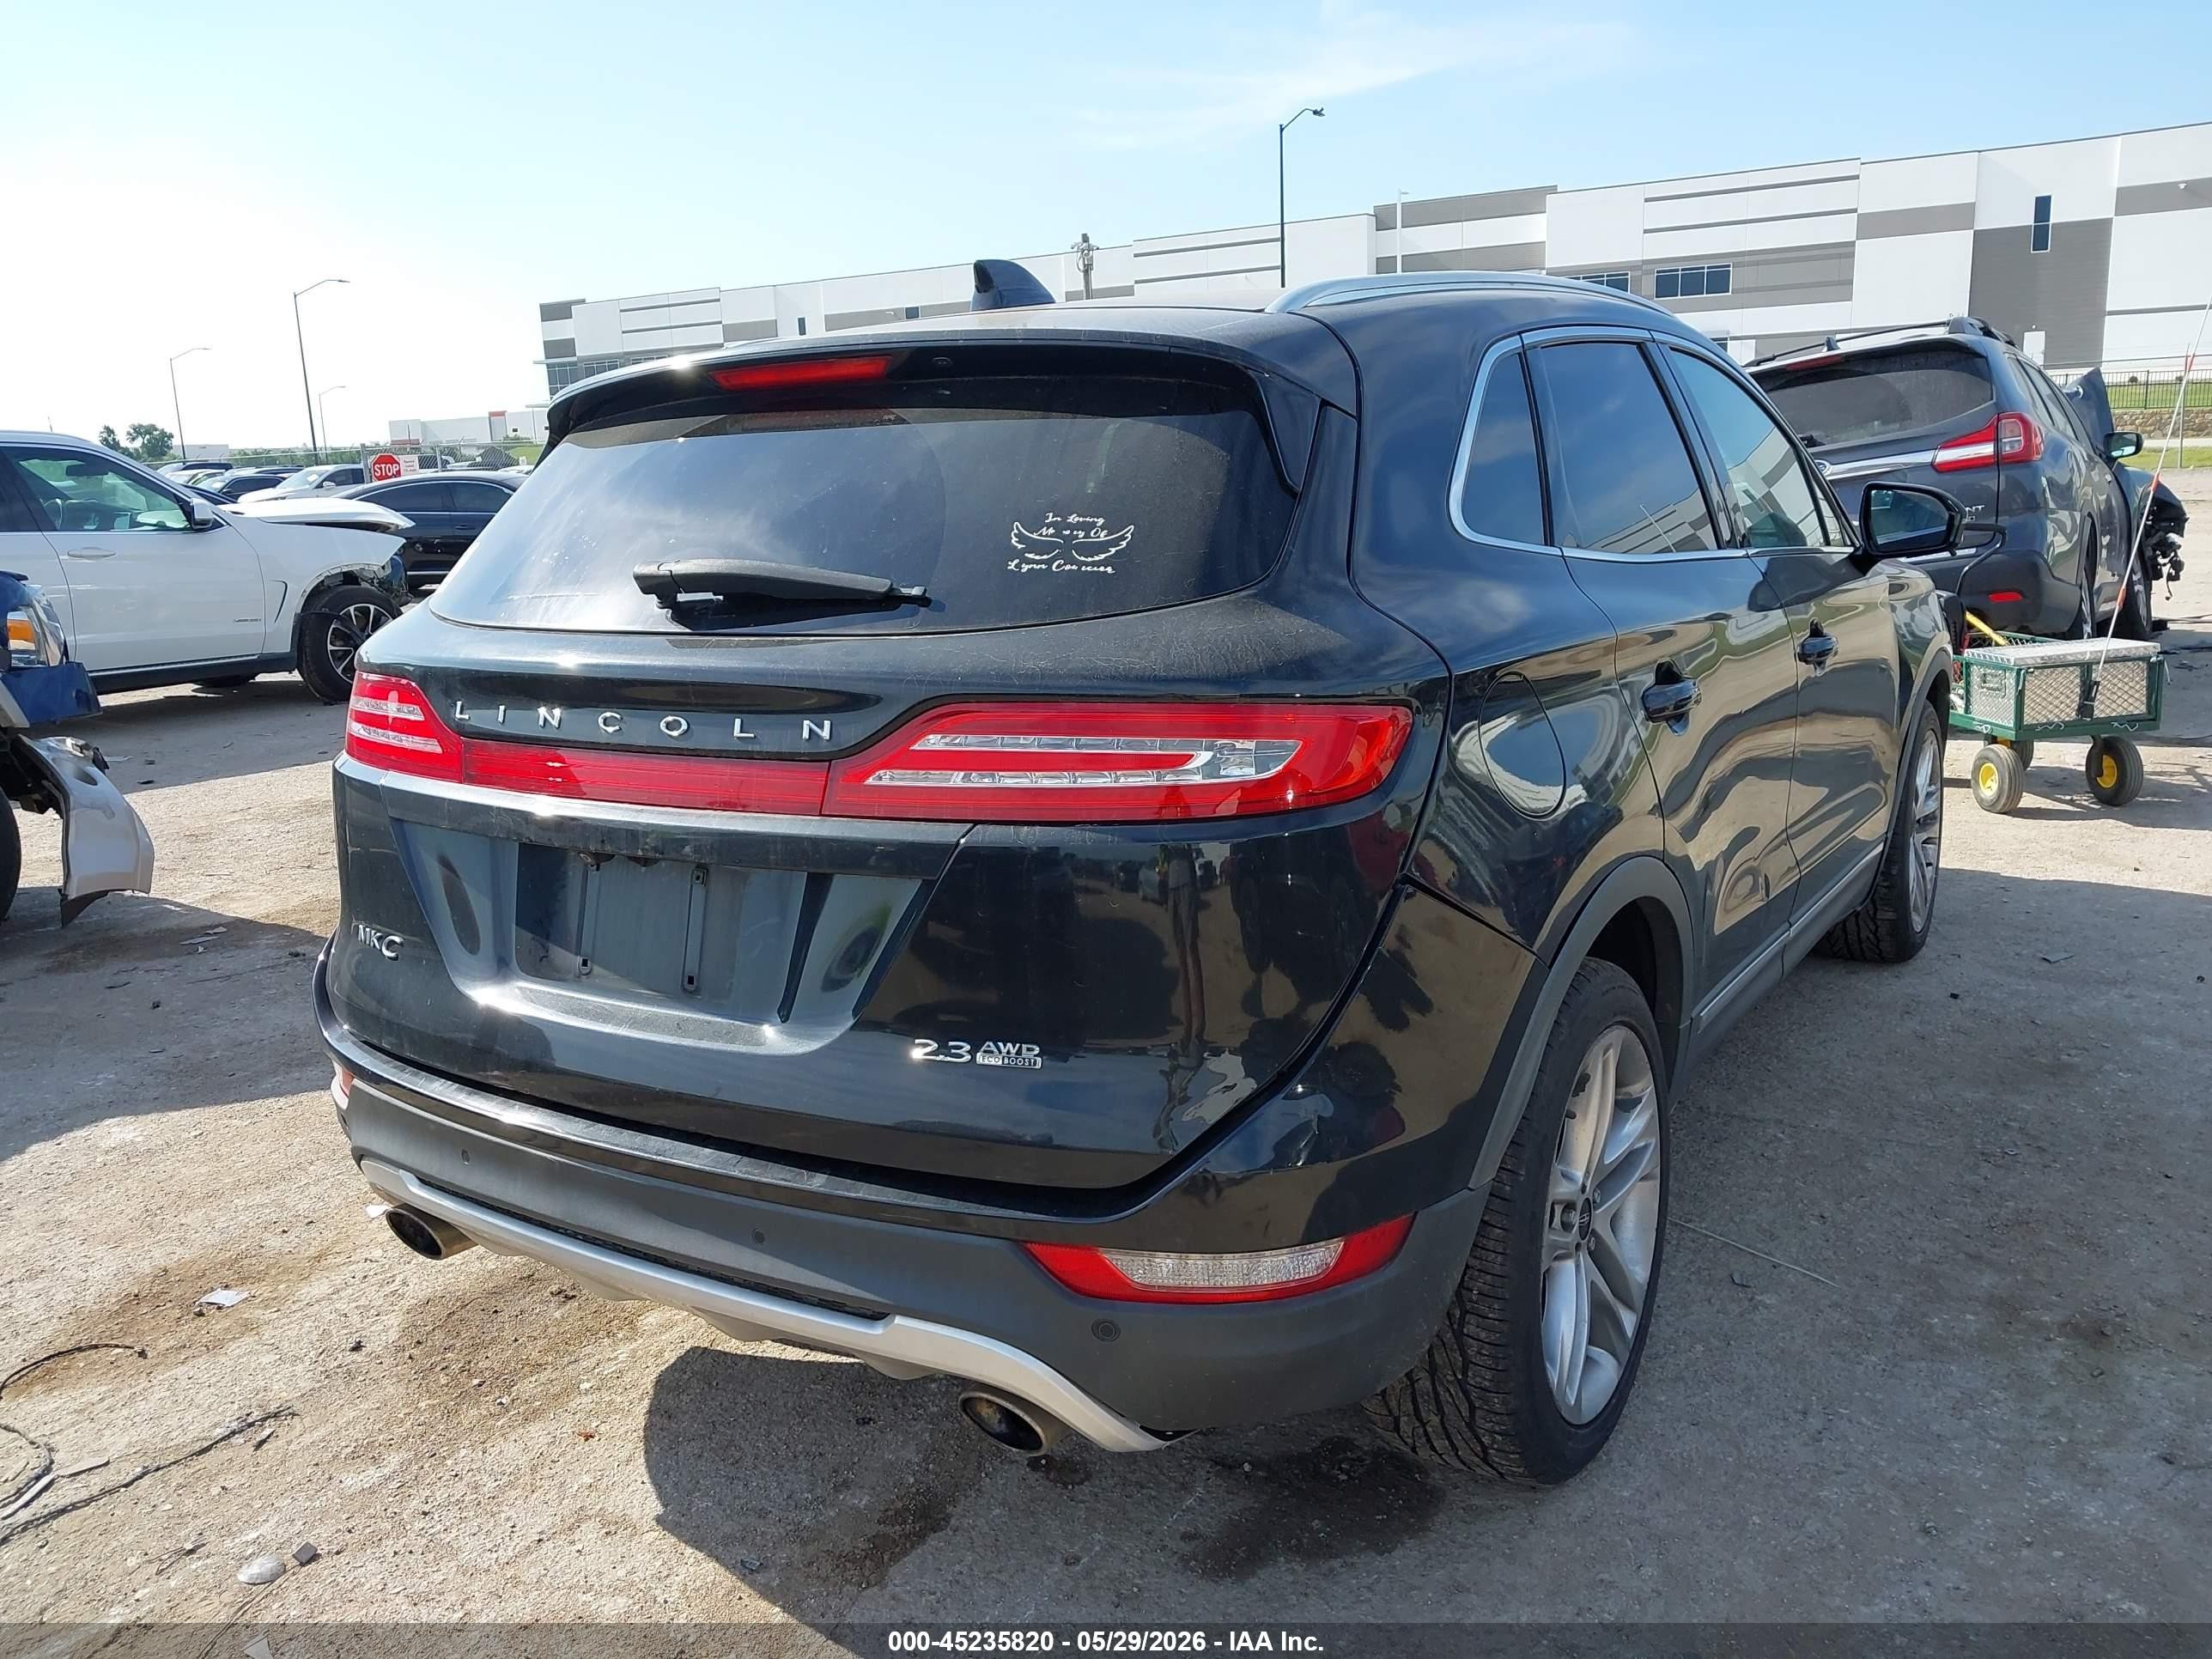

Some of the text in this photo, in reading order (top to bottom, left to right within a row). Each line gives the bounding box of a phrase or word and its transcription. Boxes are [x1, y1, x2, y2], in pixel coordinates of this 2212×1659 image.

[374, 464, 399, 477] STOP
[1044, 512, 1106, 527] In Loving
[1033, 526, 1085, 538] Meory
[1007, 559, 1048, 573] Lynn
[454, 701, 831, 741] LINCOLN
[357, 924, 404, 958] MKC
[980, 1041, 1041, 1057] AWD
